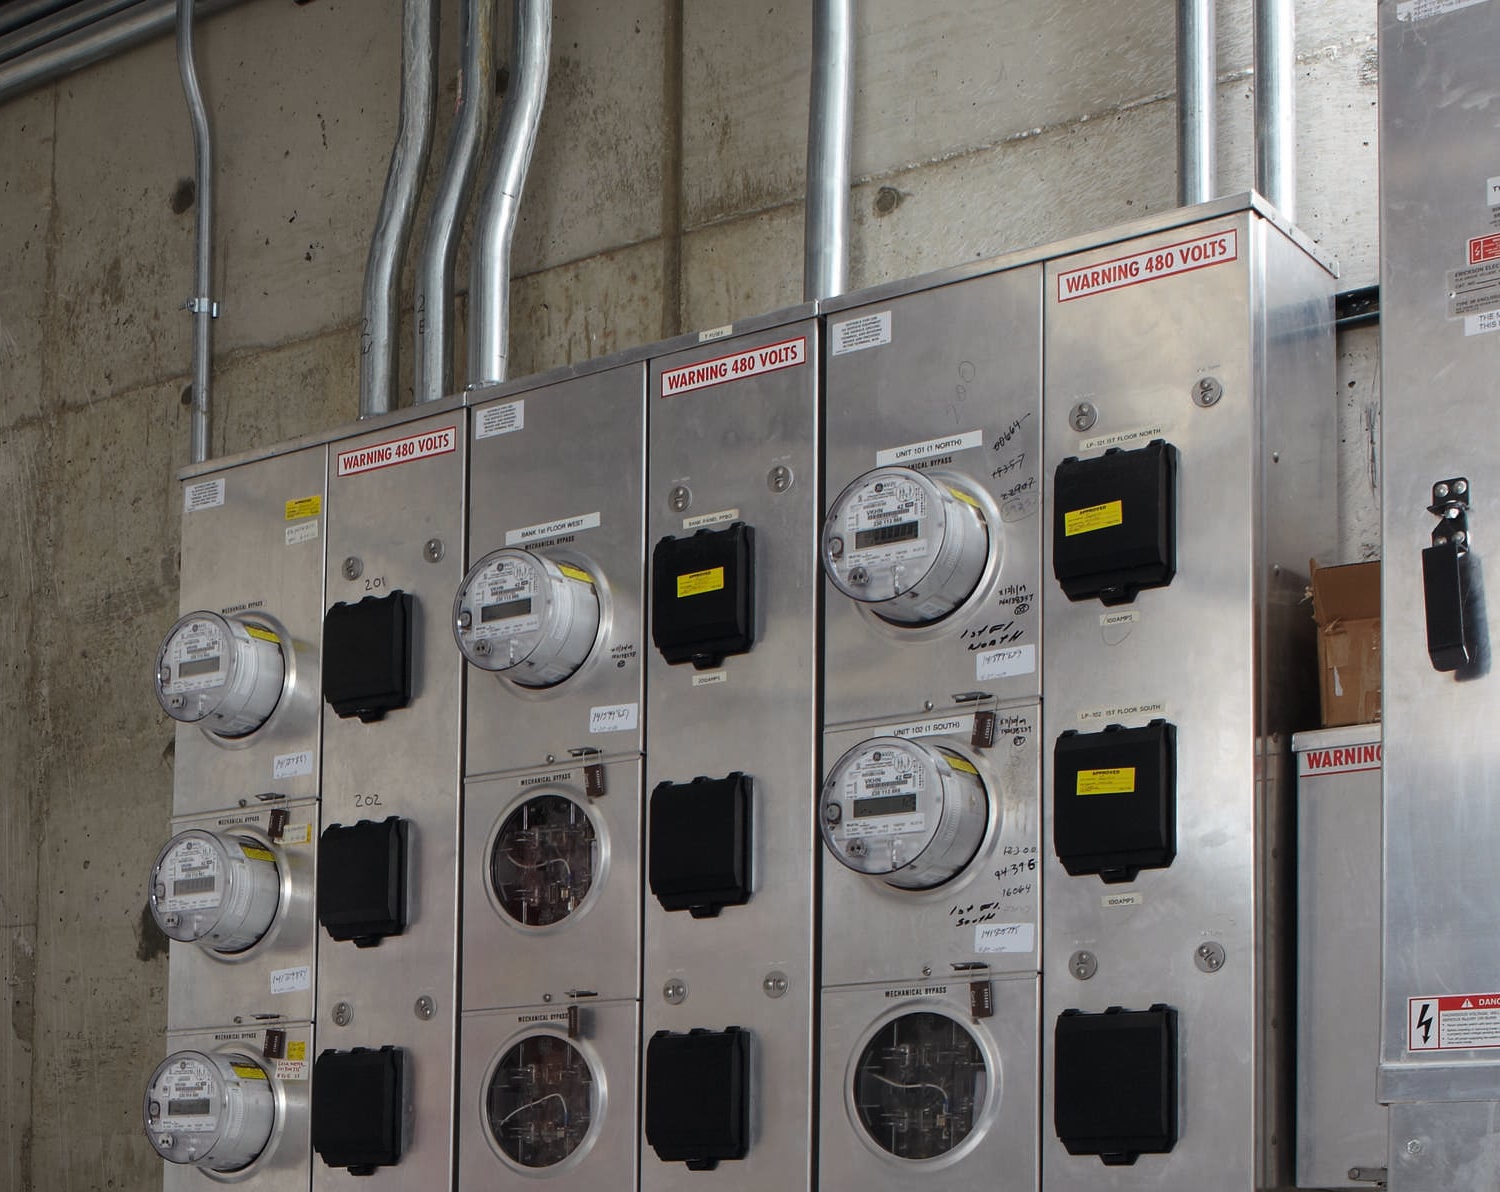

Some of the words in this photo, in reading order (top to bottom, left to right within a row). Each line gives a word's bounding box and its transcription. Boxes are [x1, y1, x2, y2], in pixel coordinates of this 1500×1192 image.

[1066, 261, 1140, 293] WARNING
[1145, 252, 1173, 273] 480
[1179, 238, 1227, 265] VOLTS
[668, 363, 728, 390] WARNING
[731, 356, 755, 374] 480
[759, 345, 798, 367] VOLTS
[343, 446, 392, 470] WARNING
[395, 442, 415, 458] 480
[418, 433, 449, 453] VOLTS
[896, 449, 912, 458] UNIT
[914, 446, 925, 454] 101
[930, 456, 952, 467] BYPASS
[521, 529, 536, 538] BANK
[547, 524, 566, 533] FLOOR
[365, 576, 386, 590] 201
[893, 728, 910, 736] UNIT
[933, 722, 961, 730] SOUTH)
[521, 776, 551, 786] MECHANICAL
[553, 773, 571, 782] BYPASS
[355, 794, 382, 807] 202
[885, 989, 923, 998] MECHANICAL
[925, 986, 947, 995] BYPASS
